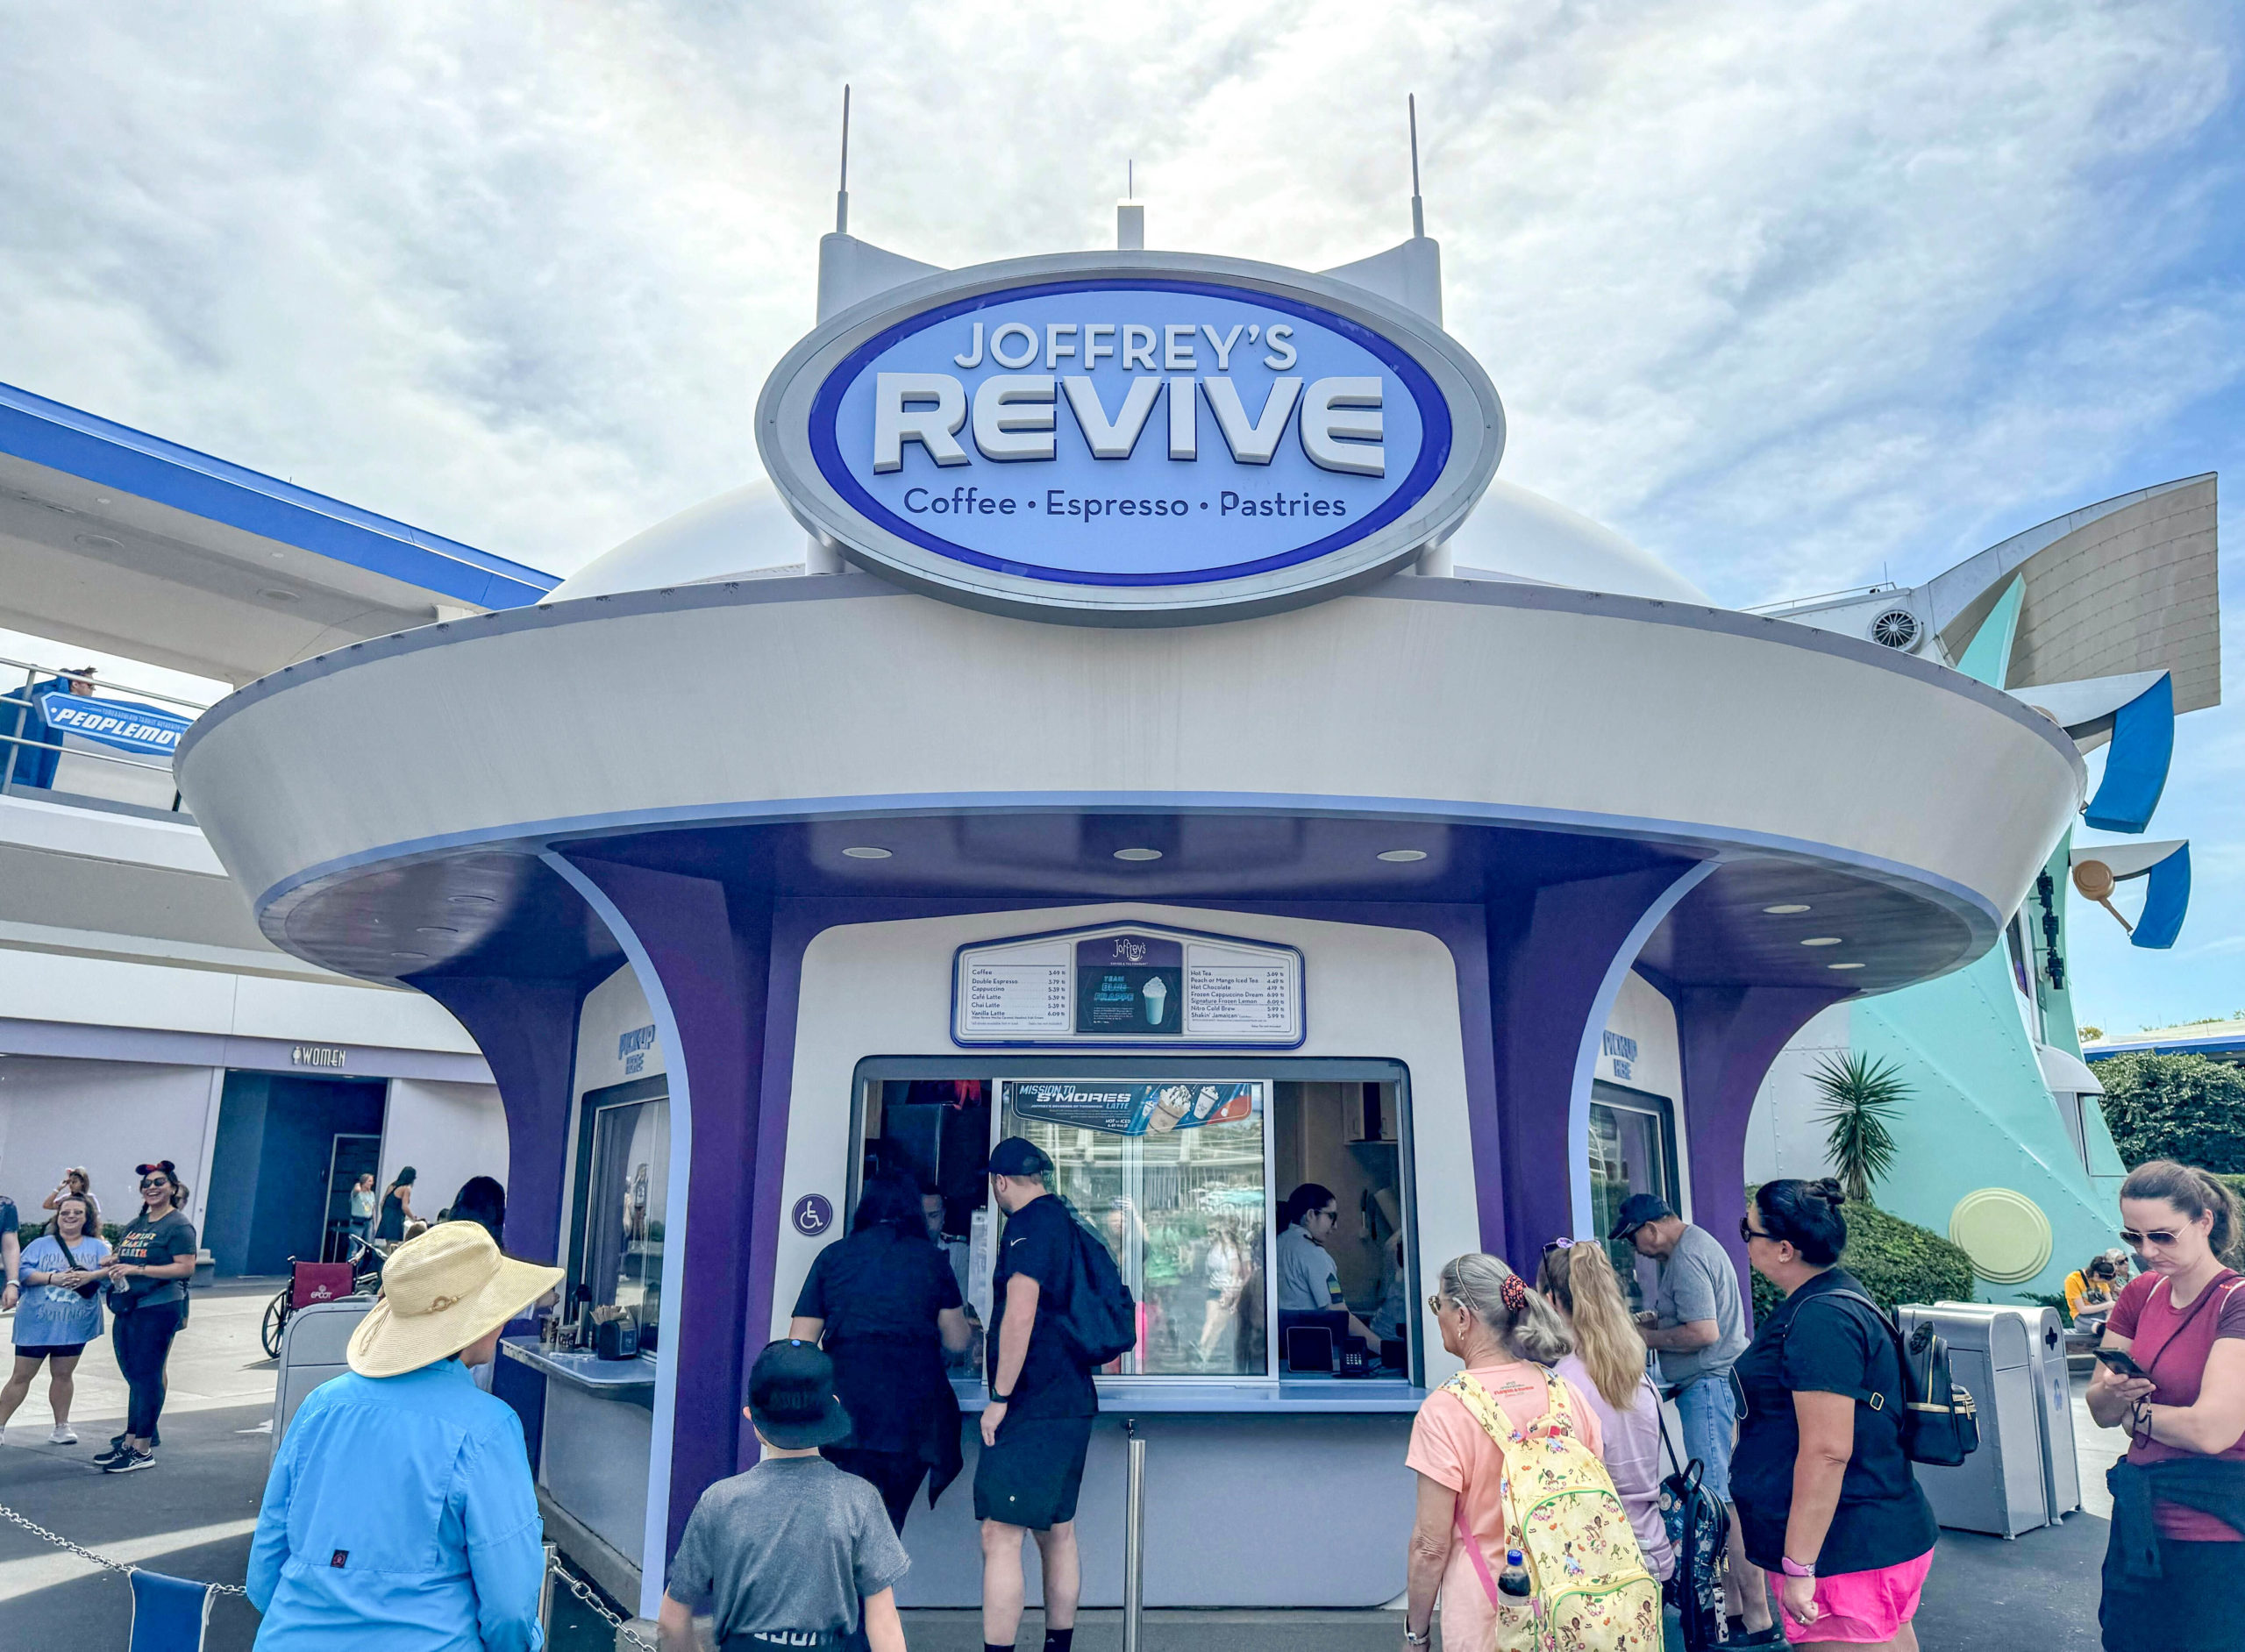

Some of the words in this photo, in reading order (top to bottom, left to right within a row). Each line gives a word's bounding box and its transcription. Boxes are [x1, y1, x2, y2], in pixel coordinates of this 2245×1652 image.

[953, 322, 1297, 371] JOFFREY'S
[873, 372, 1385, 479] REVIVE
[903, 487, 1016, 516] Coffee
[1046, 489, 1188, 523] Espresso
[1220, 489, 1346, 517] Pastries
[302, 1047, 346, 1067] WOMEN
[1019, 1085, 1062, 1095] MISSION
[1063, 1085, 1076, 1094] TO
[1037, 1093, 1131, 1102] S'MORES
